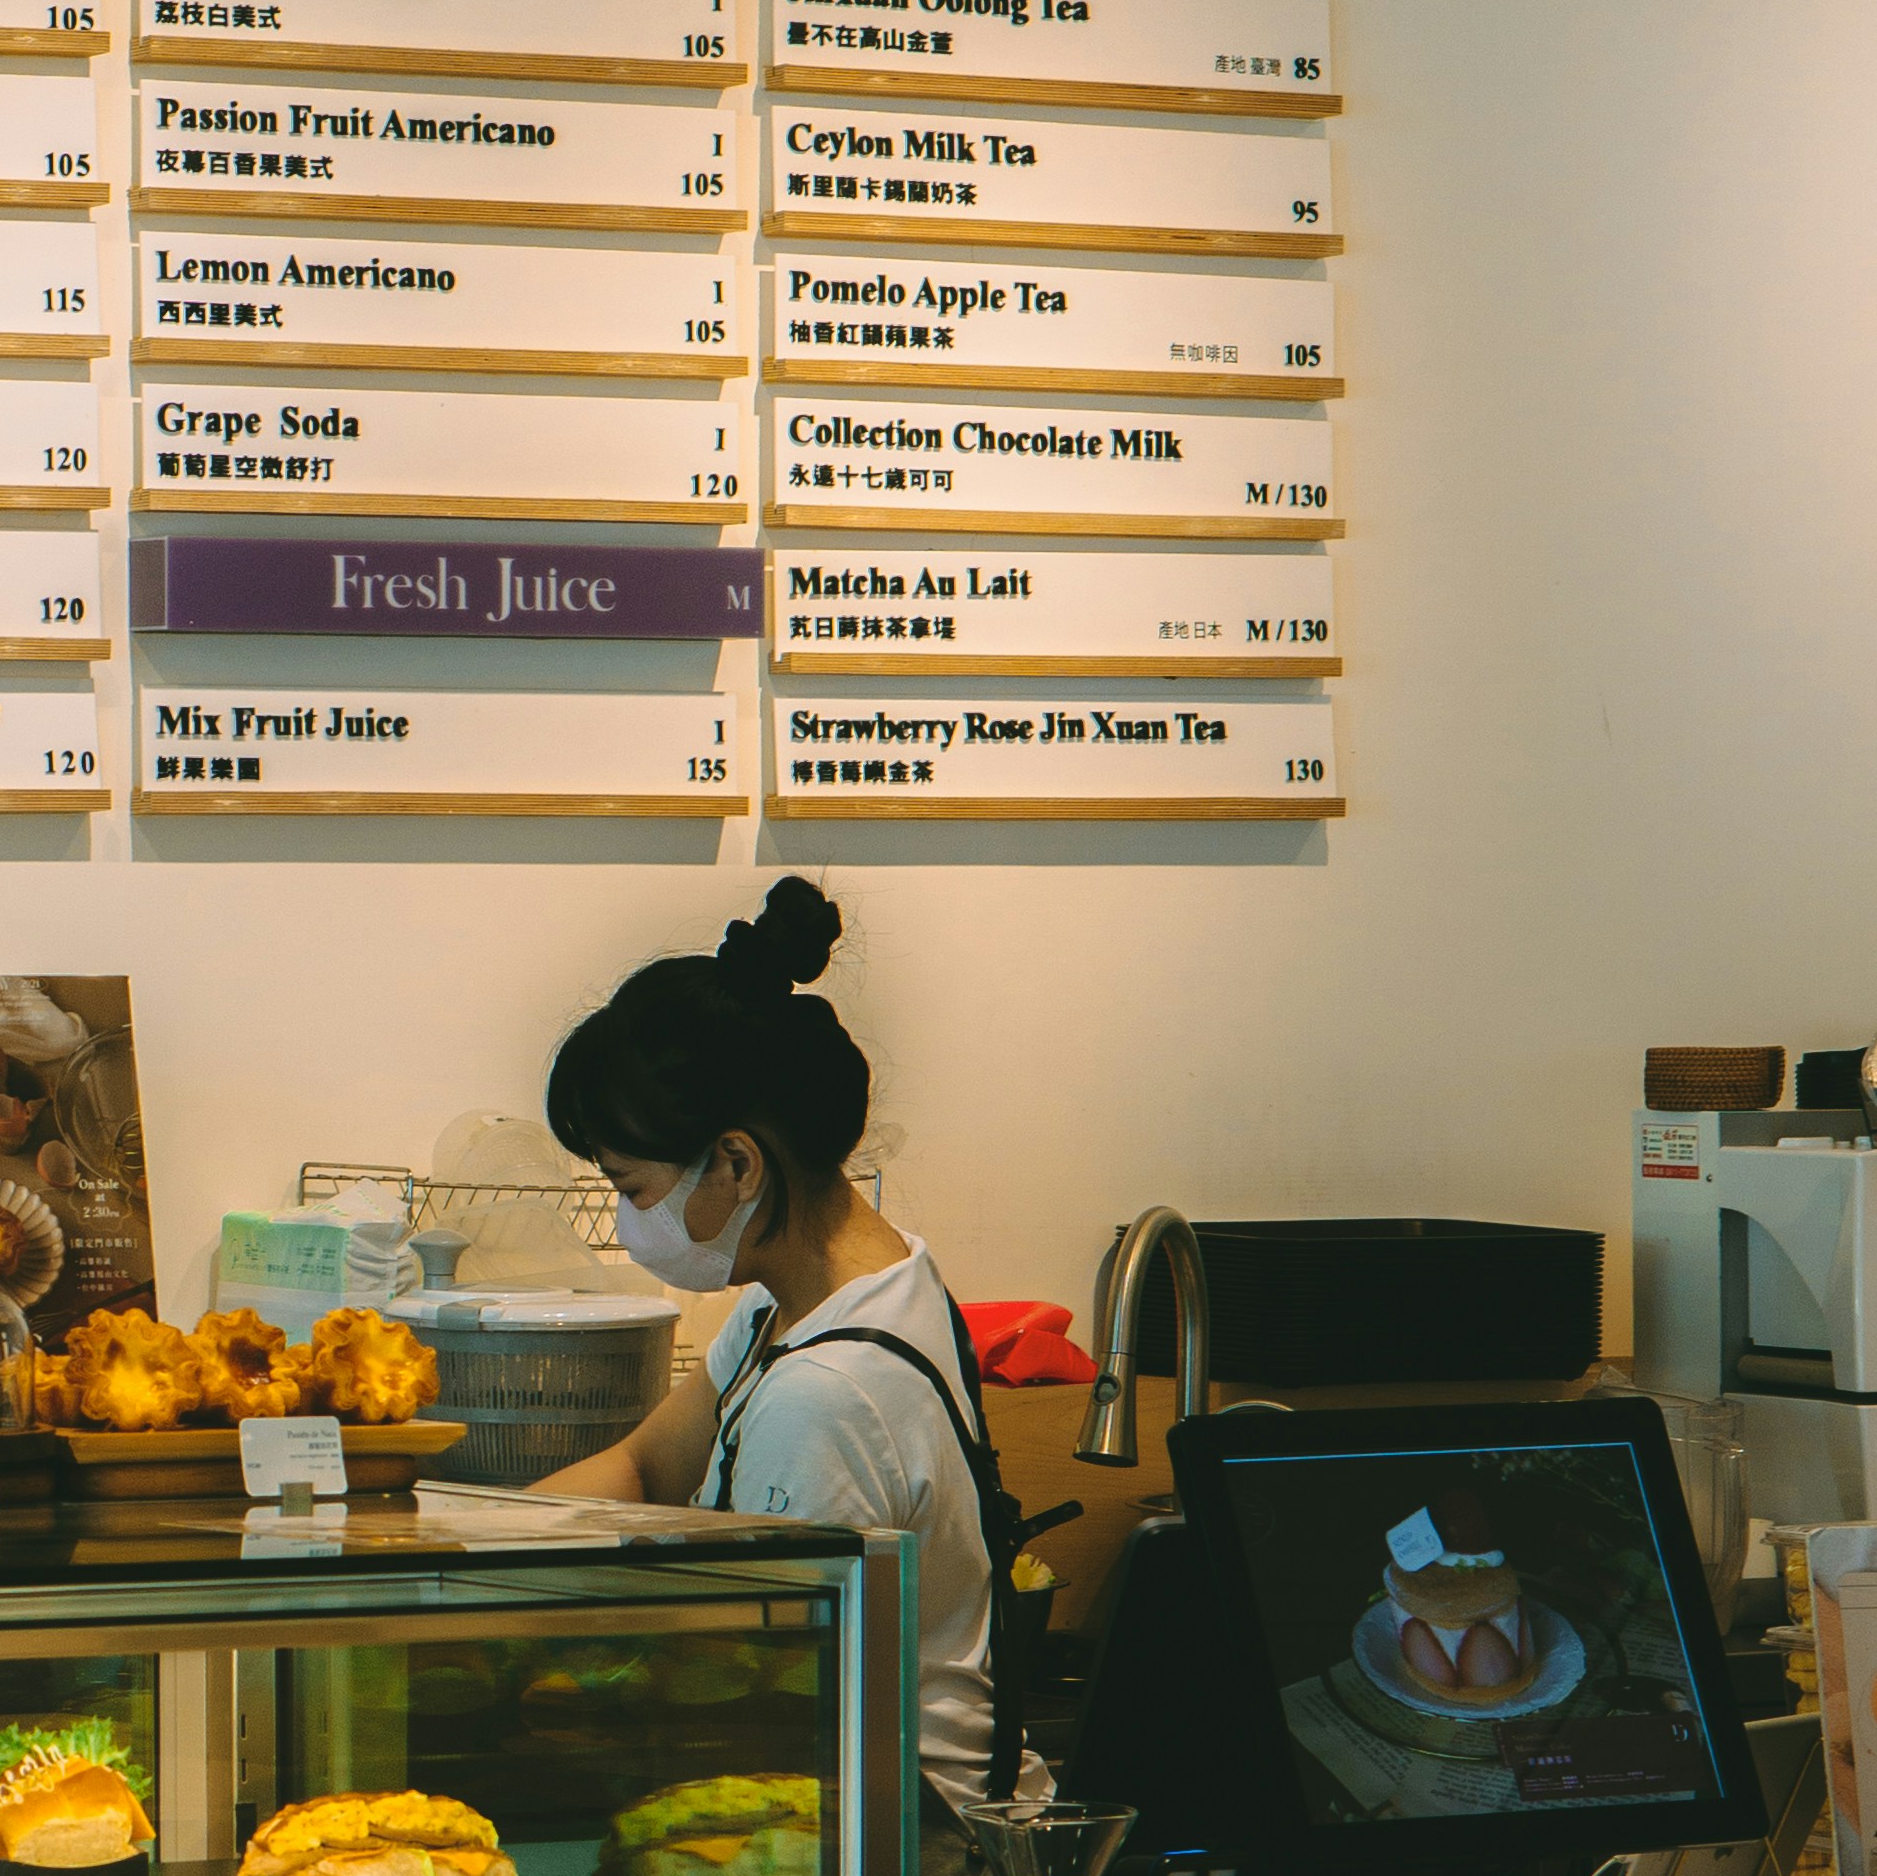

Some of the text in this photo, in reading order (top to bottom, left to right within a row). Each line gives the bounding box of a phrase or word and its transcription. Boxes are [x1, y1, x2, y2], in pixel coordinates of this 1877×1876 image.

[49, 6, 94, 34] 105
[684, 34, 725, 59] 105
[1294, 57, 1321, 81] 85
[157, 98, 555, 147] Passion Fruit Americano
[787, 123, 1037, 166] Ceylon Milk Tea
[46, 152, 91, 177] 105
[683, 173, 724, 197] 105
[1292, 200, 1319, 224] 95
[157, 250, 456, 292] Lemon Americano
[44, 288, 85, 313] 115
[790, 270, 1067, 317] Pomelo Apple Tea
[158, 300, 283, 328] 西西里美式
[685, 320, 726, 343] 105
[1285, 344, 1321, 367] 105
[157, 402, 359, 443] Grape Soda
[789, 414, 1182, 460] Collection Chocolate Milk
[45, 447, 87, 472] 120
[692, 473, 738, 498] 120
[1289, 484, 1328, 508] 130
[332, 554, 616, 622] Fresh Juice
[789, 566, 1031, 599] Matcha Au Lait
[41, 597, 85, 622] 120
[1290, 619, 1328, 642] 130
[158, 705, 409, 739] Mix Fruit Juice
[791, 710, 1227, 750] Strawberry Rose Jin Xuan Tea
[45, 750, 95, 775] 120
[688, 757, 727, 782] 135
[1286, 759, 1324, 782] 130
[78, 1178, 120, 1190] On Sale
[765, 1485, 789, 1513] D
